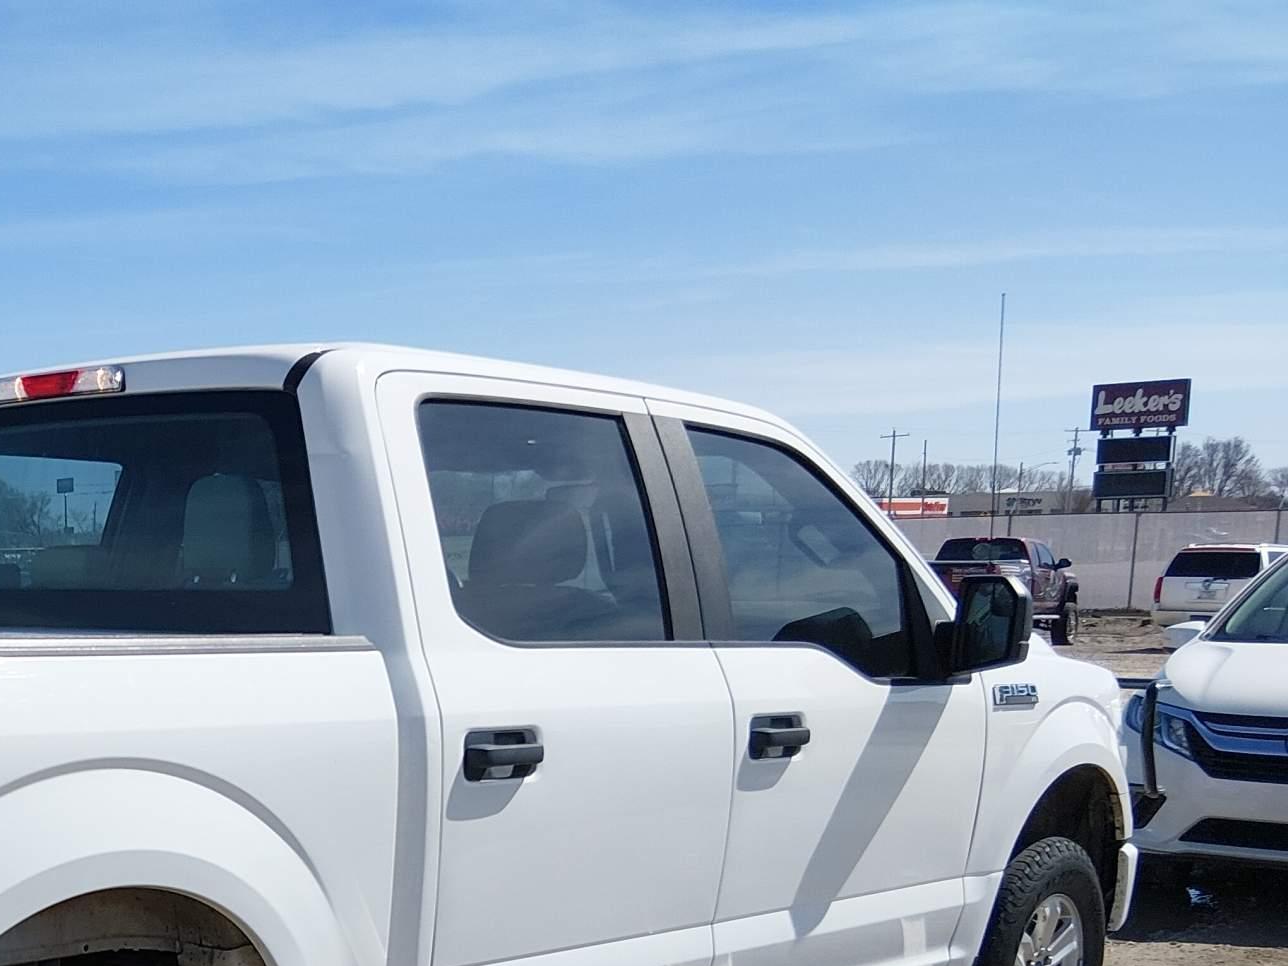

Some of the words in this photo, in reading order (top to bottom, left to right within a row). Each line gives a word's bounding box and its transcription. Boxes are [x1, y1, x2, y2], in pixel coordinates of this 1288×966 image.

[1094, 388, 1183, 415] Leeker's
[1097, 416, 1137, 425] FAMILY
[1140, 414, 1177, 423] FOODS
